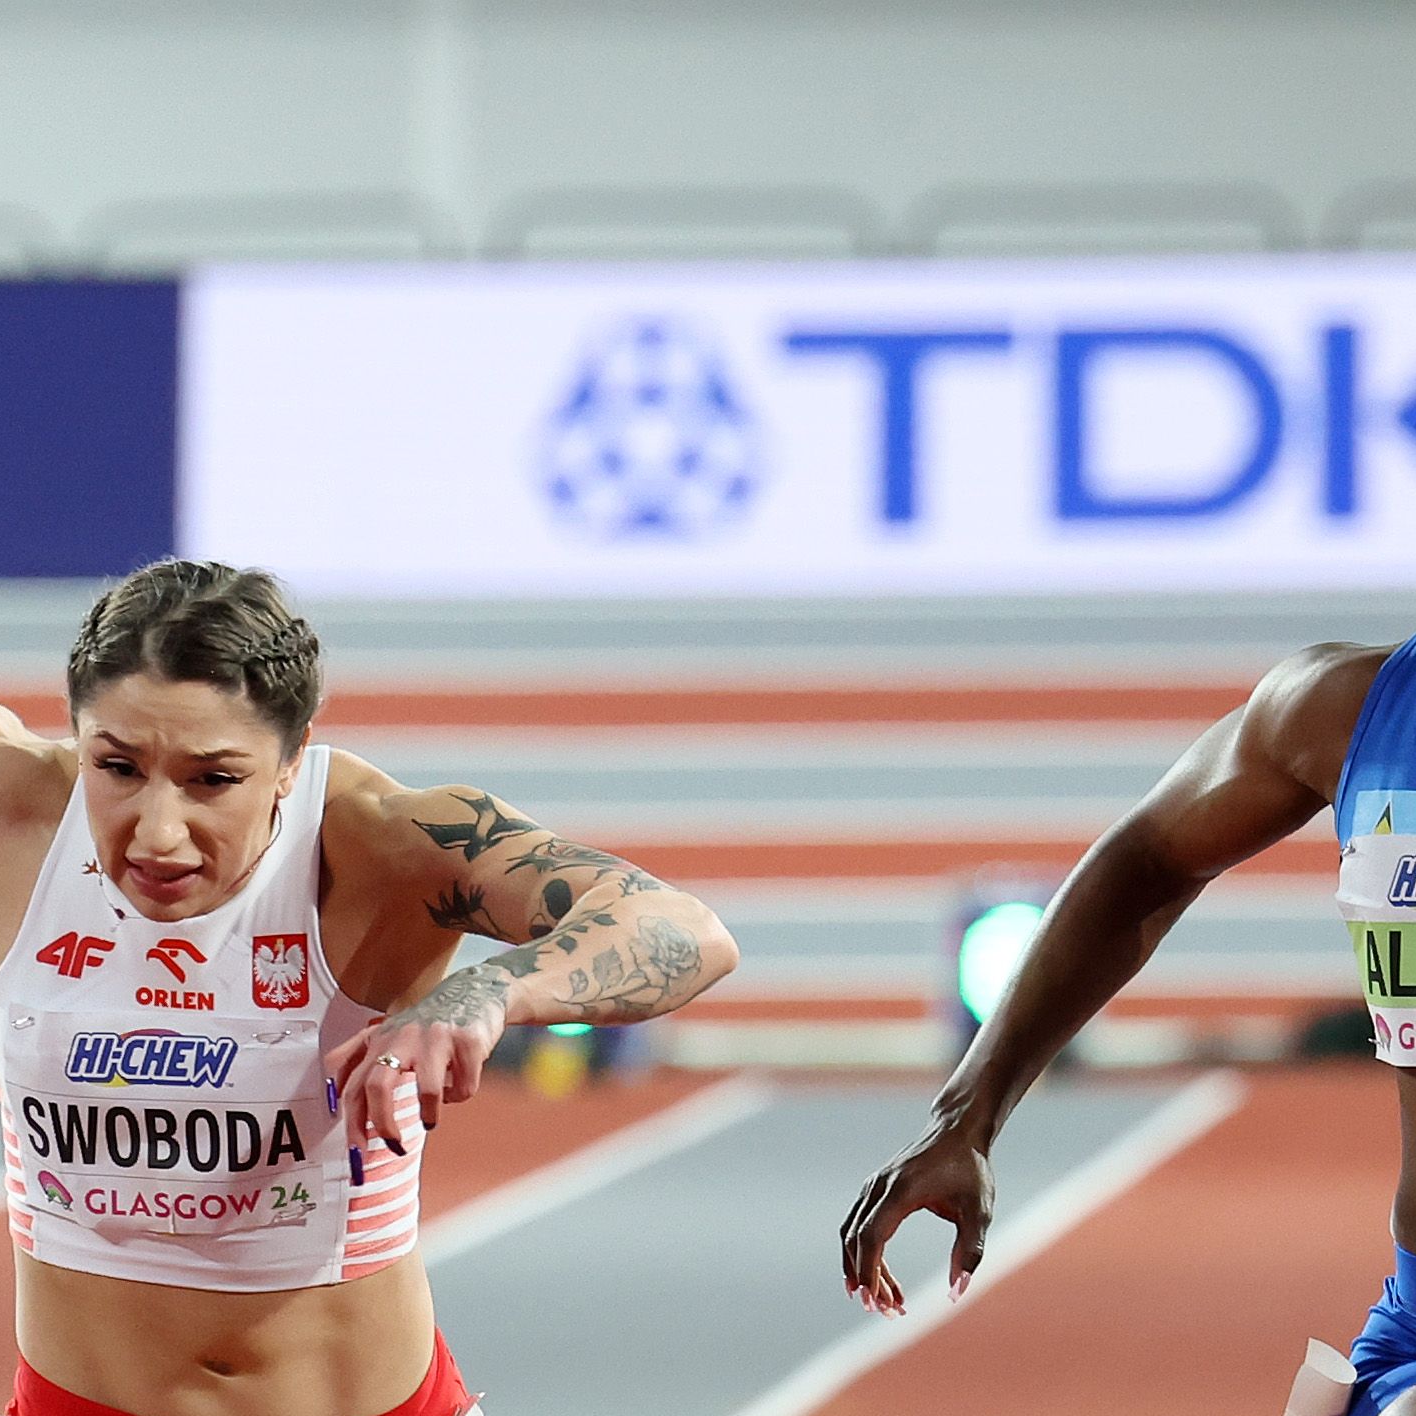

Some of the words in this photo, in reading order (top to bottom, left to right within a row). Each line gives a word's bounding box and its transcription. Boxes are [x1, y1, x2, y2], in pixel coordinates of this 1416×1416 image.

[36, 931, 115, 978] 4F
[135, 987, 215, 1011] ORLEN
[65, 1032, 237, 1088] HI-CHEW
[22, 1096, 306, 1173] SWOBODA
[84, 1190, 260, 1220] GLASGOW
[271, 1183, 310, 1211] 24
